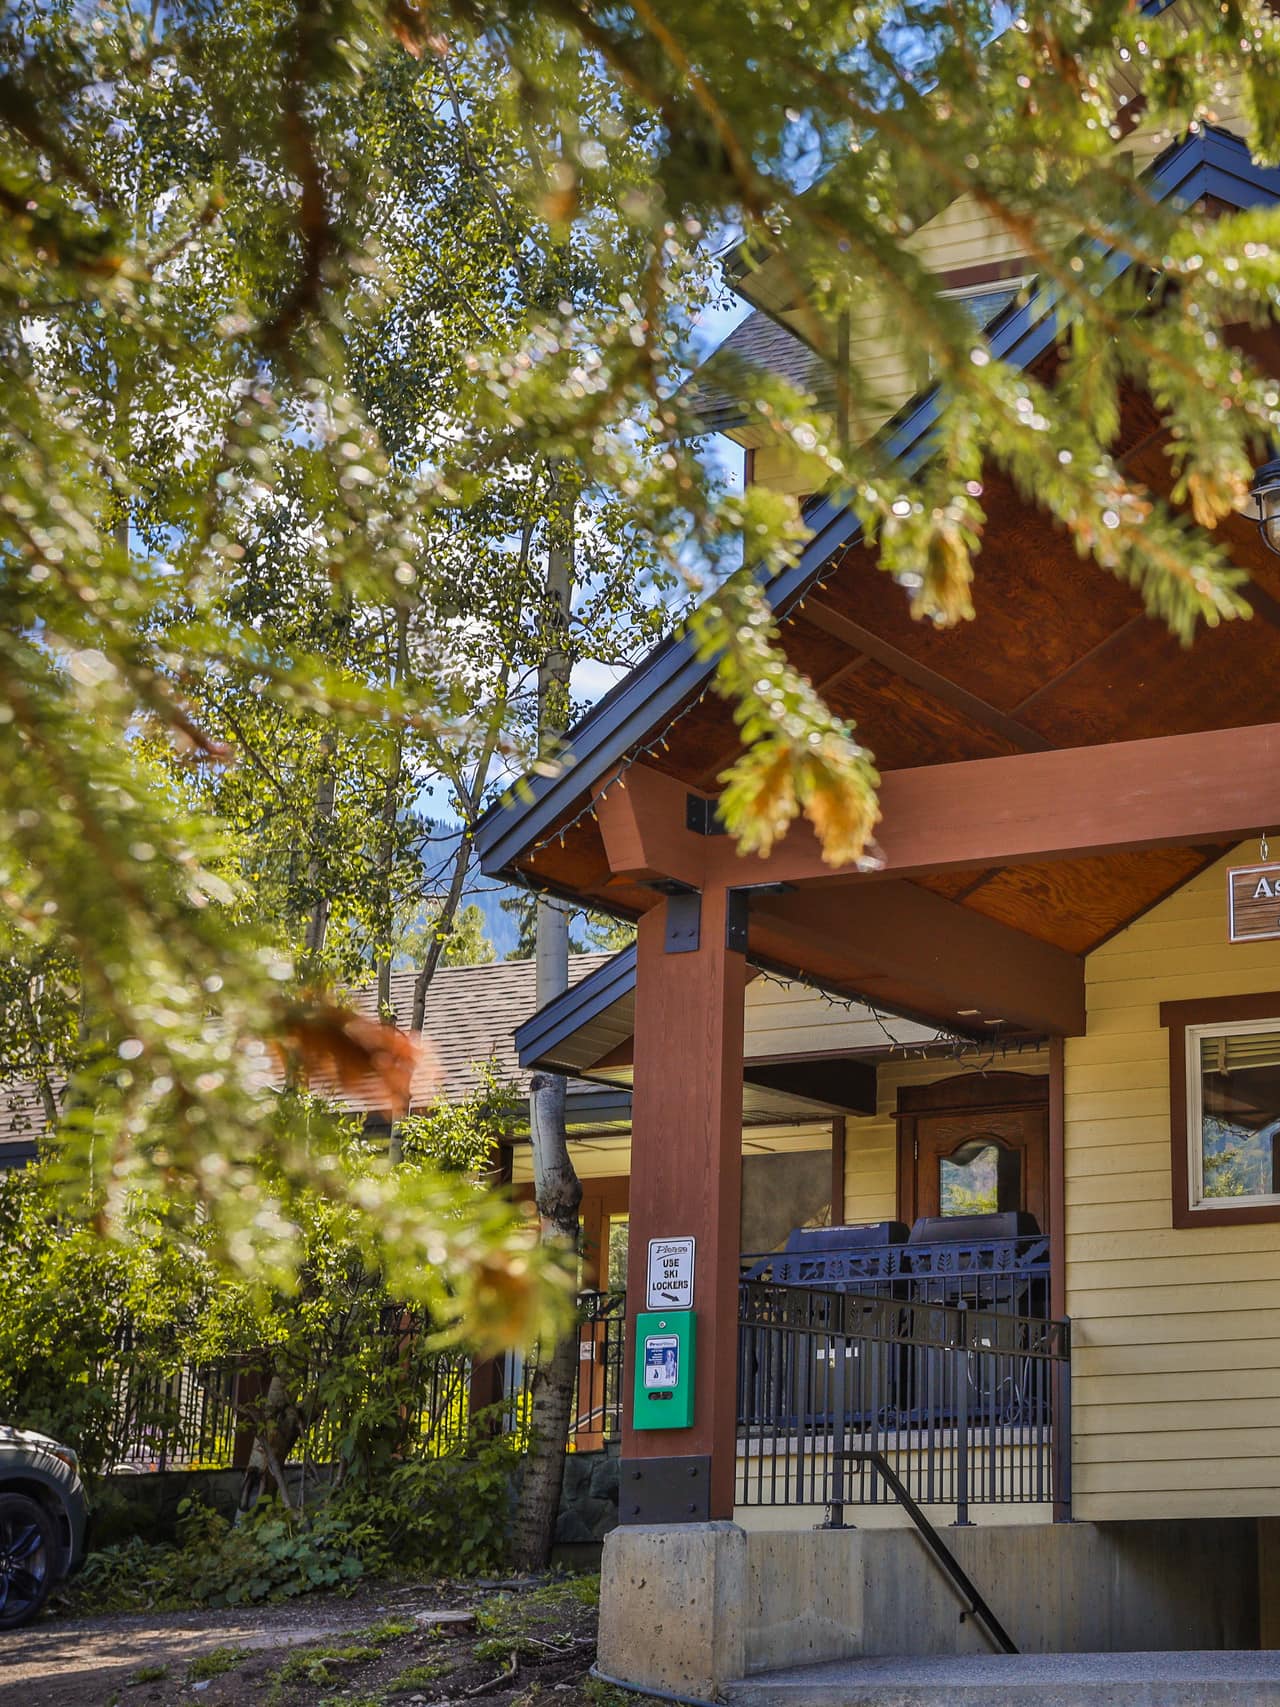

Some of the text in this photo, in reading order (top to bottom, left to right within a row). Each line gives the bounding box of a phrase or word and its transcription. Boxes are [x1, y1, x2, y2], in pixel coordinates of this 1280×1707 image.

[663, 1258, 680, 1268] USE
[663, 1269, 678, 1279] SKI
[652, 1280, 689, 1291] LOCKERS
